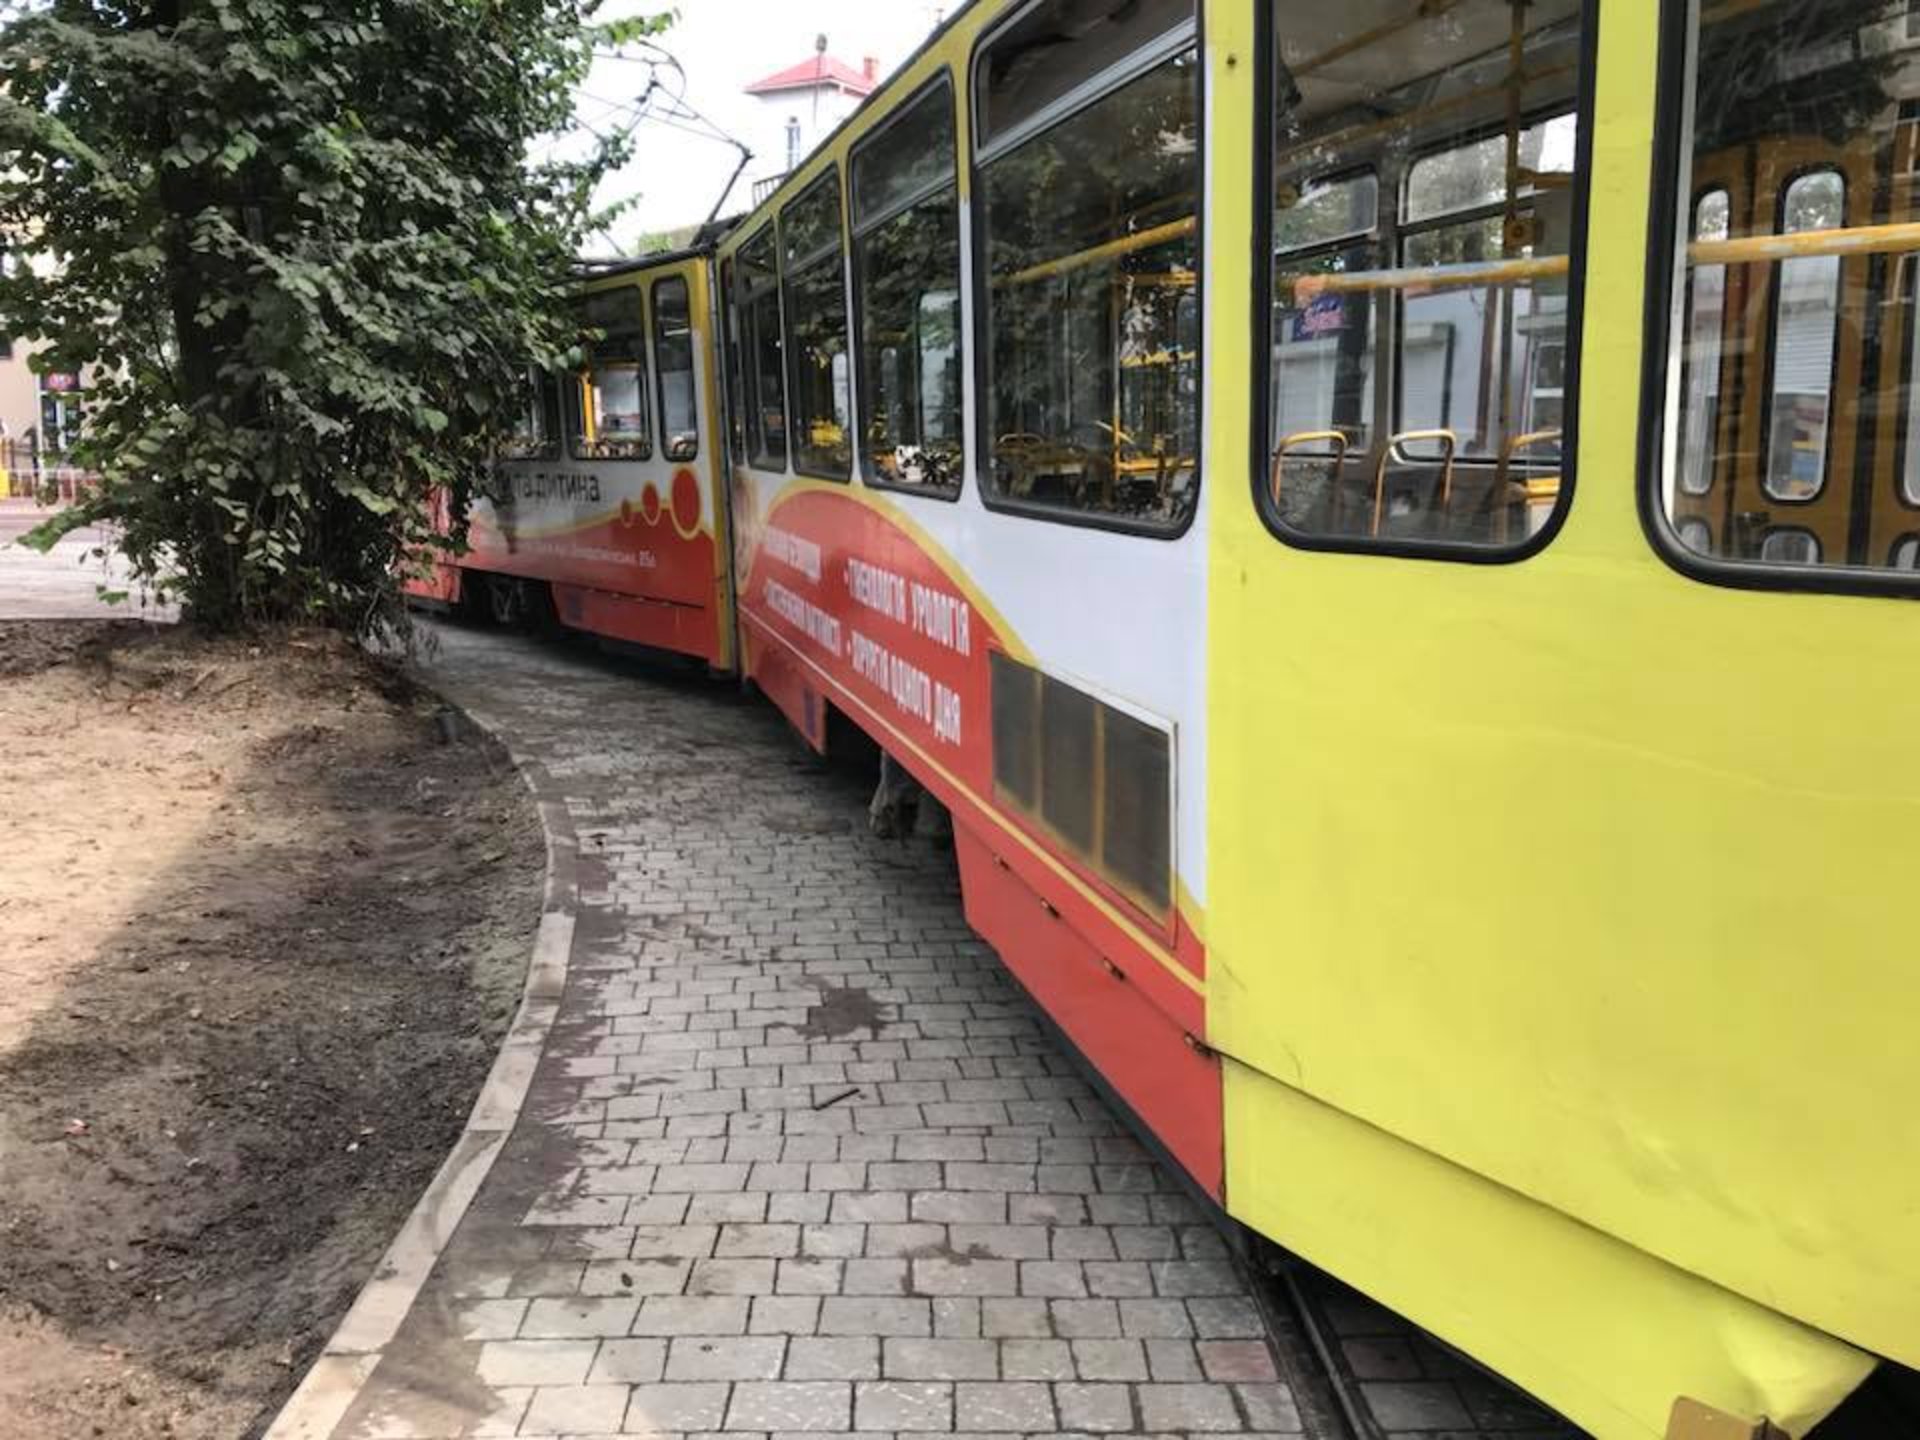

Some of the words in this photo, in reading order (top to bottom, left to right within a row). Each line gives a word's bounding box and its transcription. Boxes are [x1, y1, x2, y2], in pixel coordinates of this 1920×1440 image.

[910, 581, 970, 657] УРОЛОГІЯ
[890, 655, 932, 724] ОДНОГО
[934, 682, 961, 748] ДНЯ
